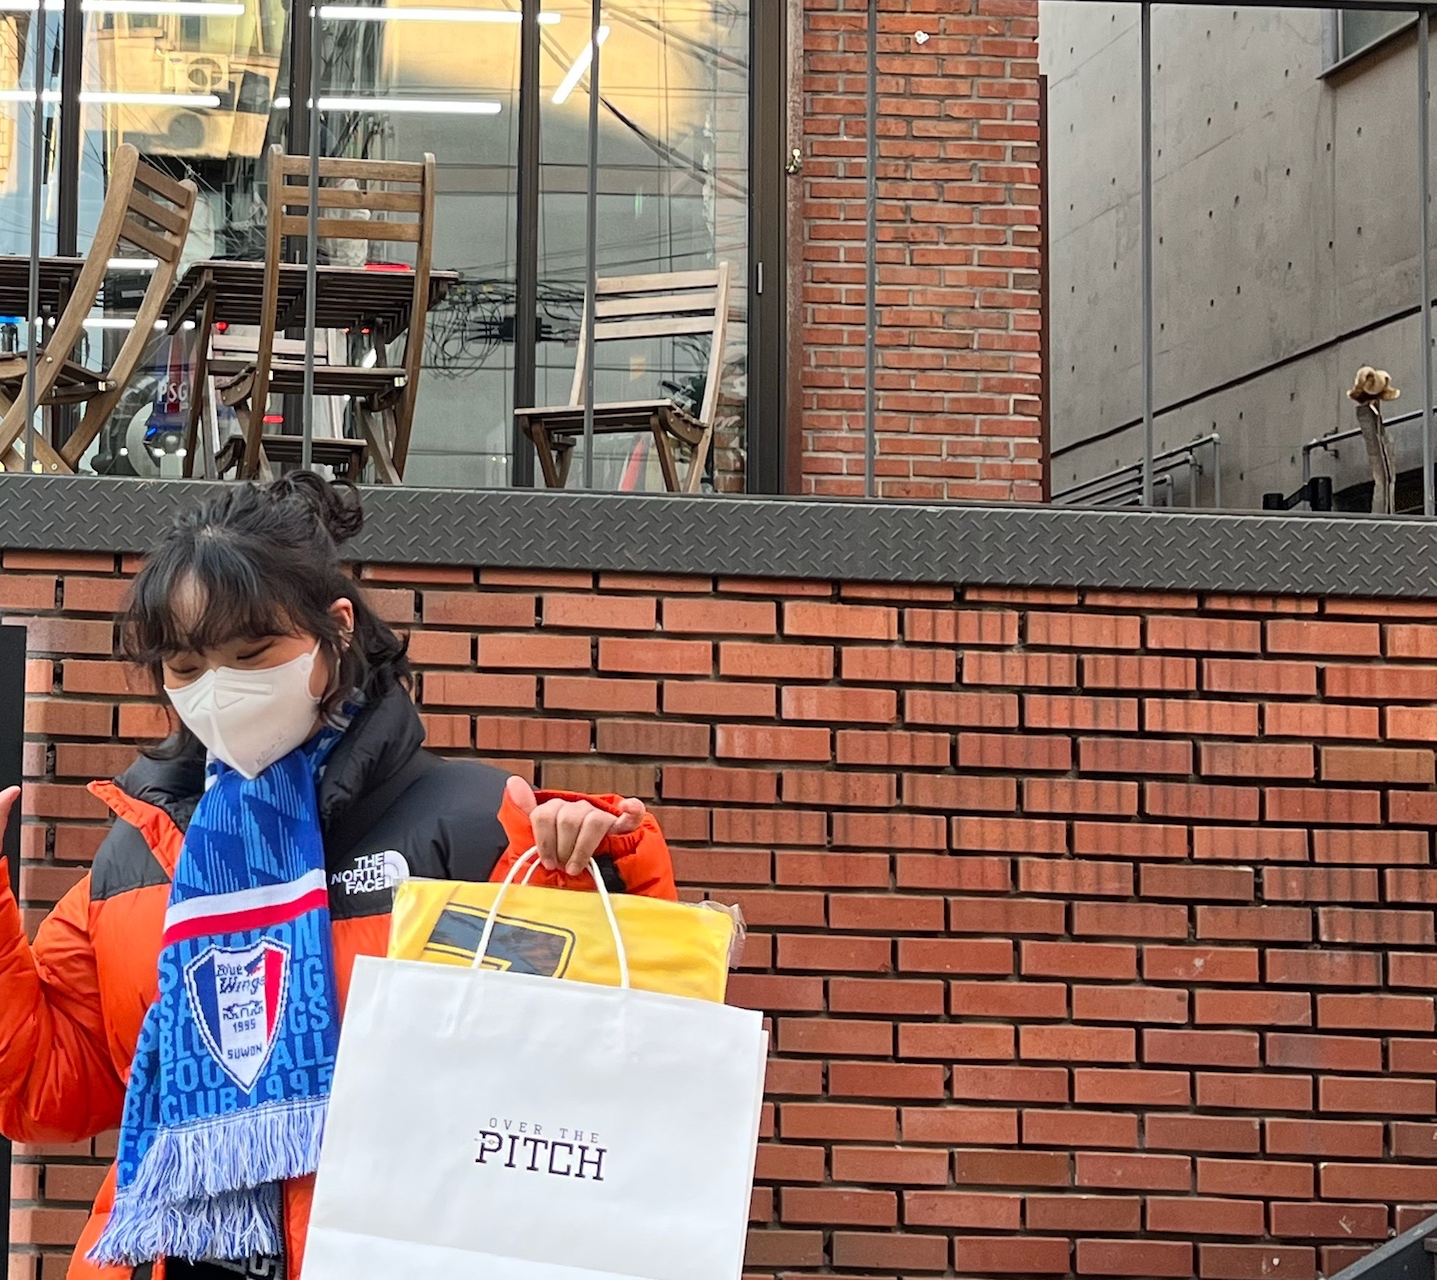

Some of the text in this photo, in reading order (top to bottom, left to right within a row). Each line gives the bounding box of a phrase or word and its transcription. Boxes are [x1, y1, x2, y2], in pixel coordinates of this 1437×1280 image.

[157, 378, 189, 403] PSG
[354, 851, 385, 868] THE
[330, 864, 384, 886] NORTH
[345, 876, 384, 895] FACE
[232, 1019, 257, 1034] 1995
[227, 1042, 264, 1061] SUWON
[160, 1086, 239, 1124] CLUB
[488, 1117, 600, 1144] OVER THE
[474, 1129, 608, 1182] PITCH
